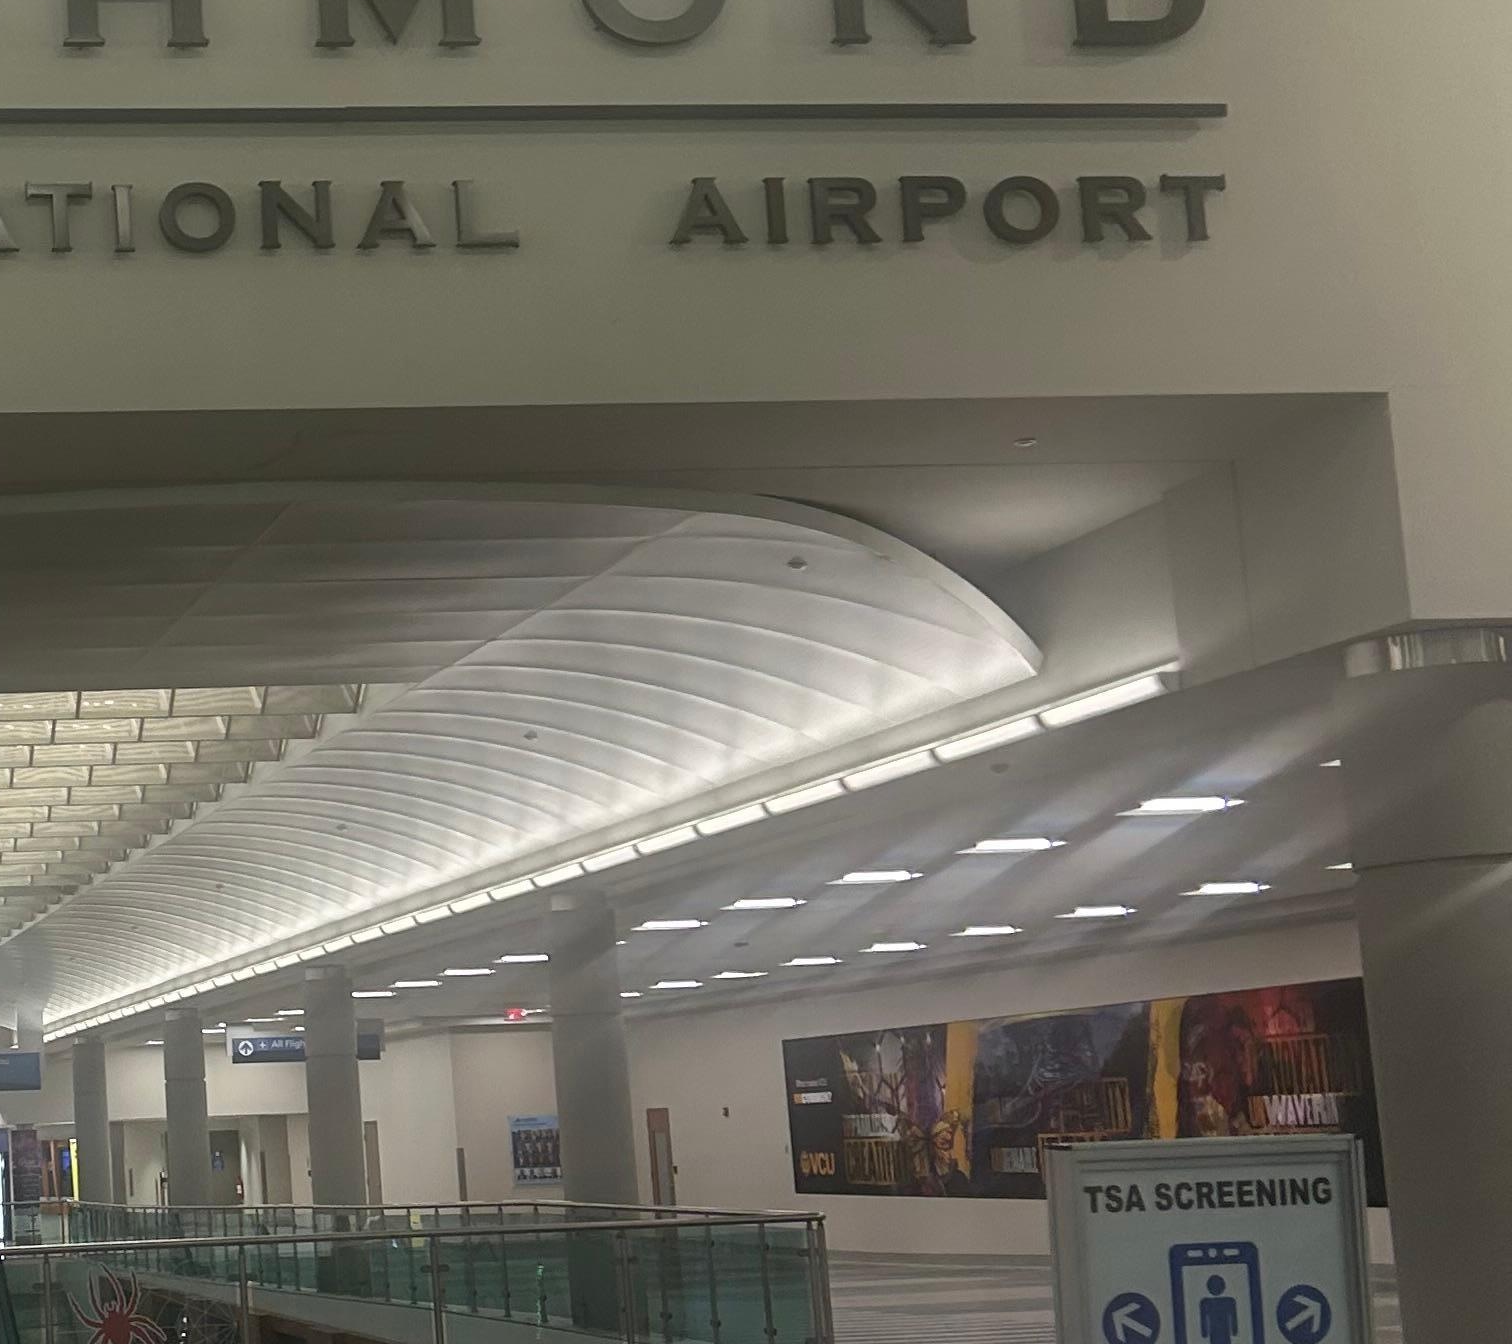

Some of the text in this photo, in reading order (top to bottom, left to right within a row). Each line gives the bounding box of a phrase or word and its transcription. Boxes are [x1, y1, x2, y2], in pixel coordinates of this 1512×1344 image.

[669, 172, 1226, 246] AIRPORT
[271, 1039, 283, 1048] All
[809, 1151, 835, 1176] VCU
[1084, 1176, 1333, 1214] TSA SCREENING
